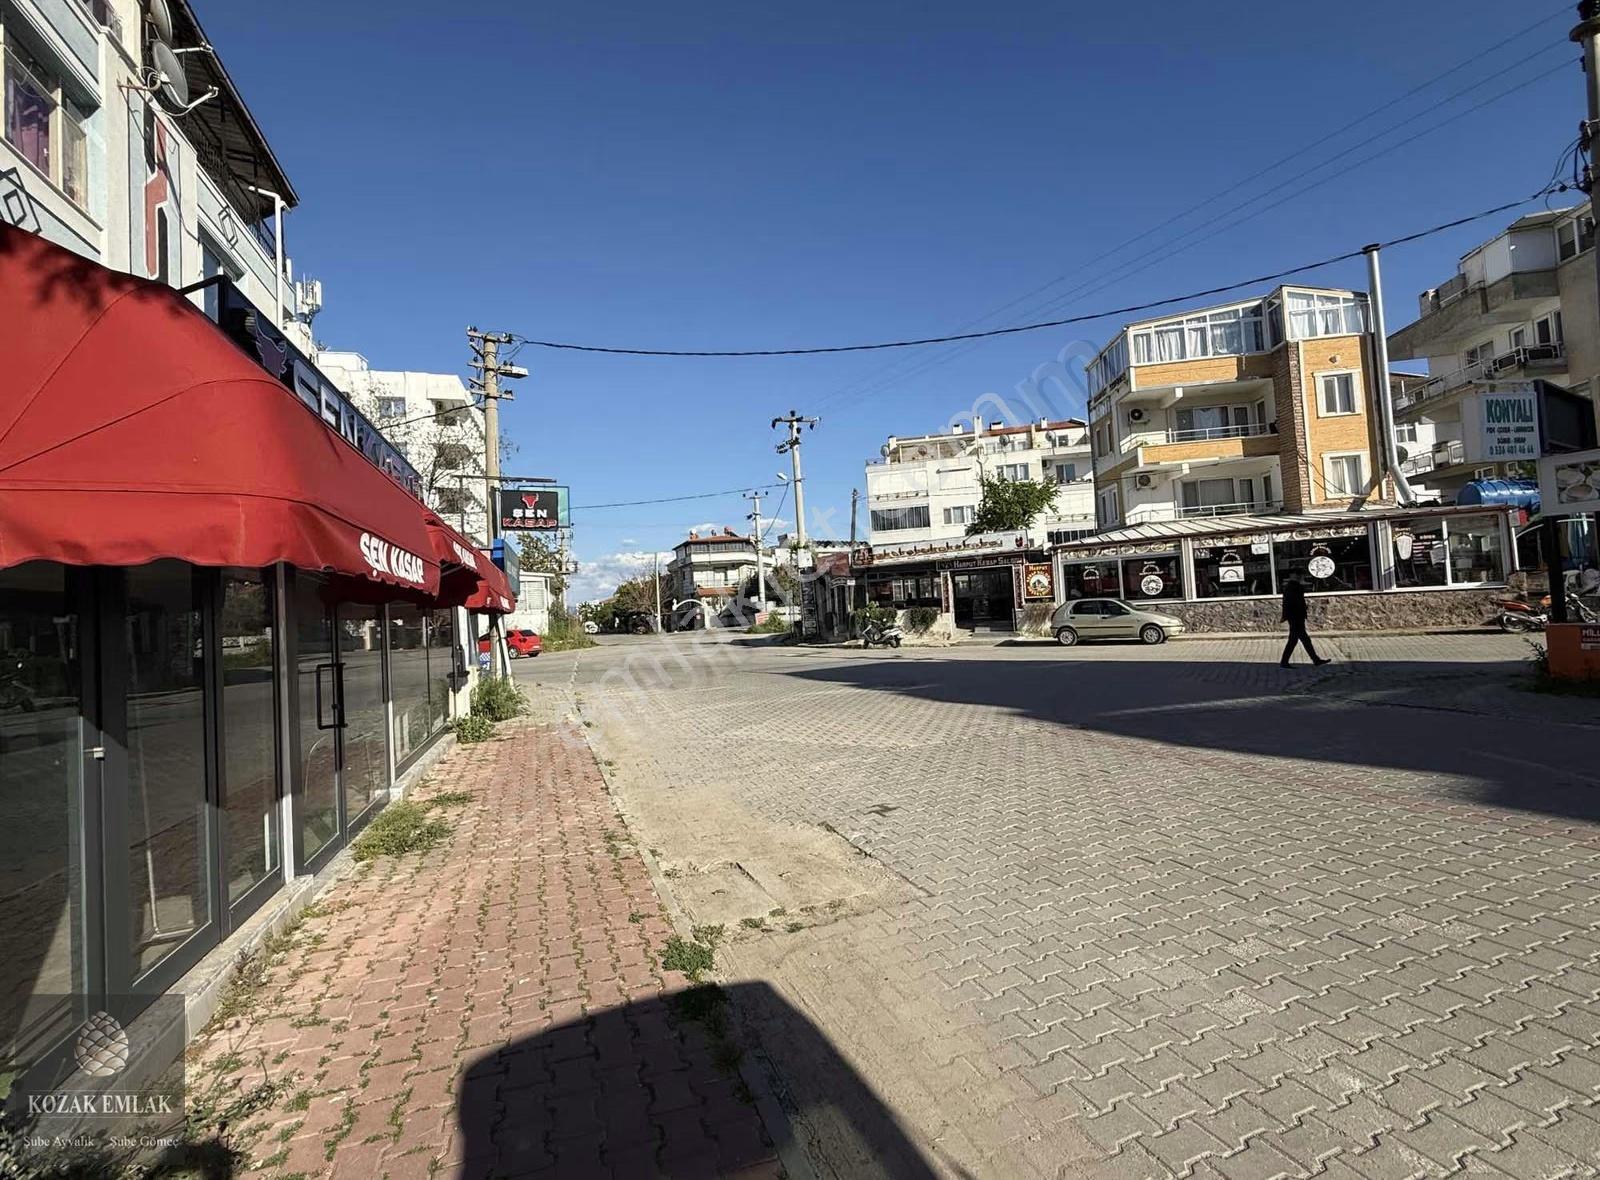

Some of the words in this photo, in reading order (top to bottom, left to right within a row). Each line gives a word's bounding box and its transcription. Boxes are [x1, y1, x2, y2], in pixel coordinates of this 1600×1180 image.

[1486, 399, 1533, 423] KONYALI
[502, 517, 558, 528] KASAP
[359, 532, 391, 577] ŞEN
[390, 545, 425, 584] KASAP
